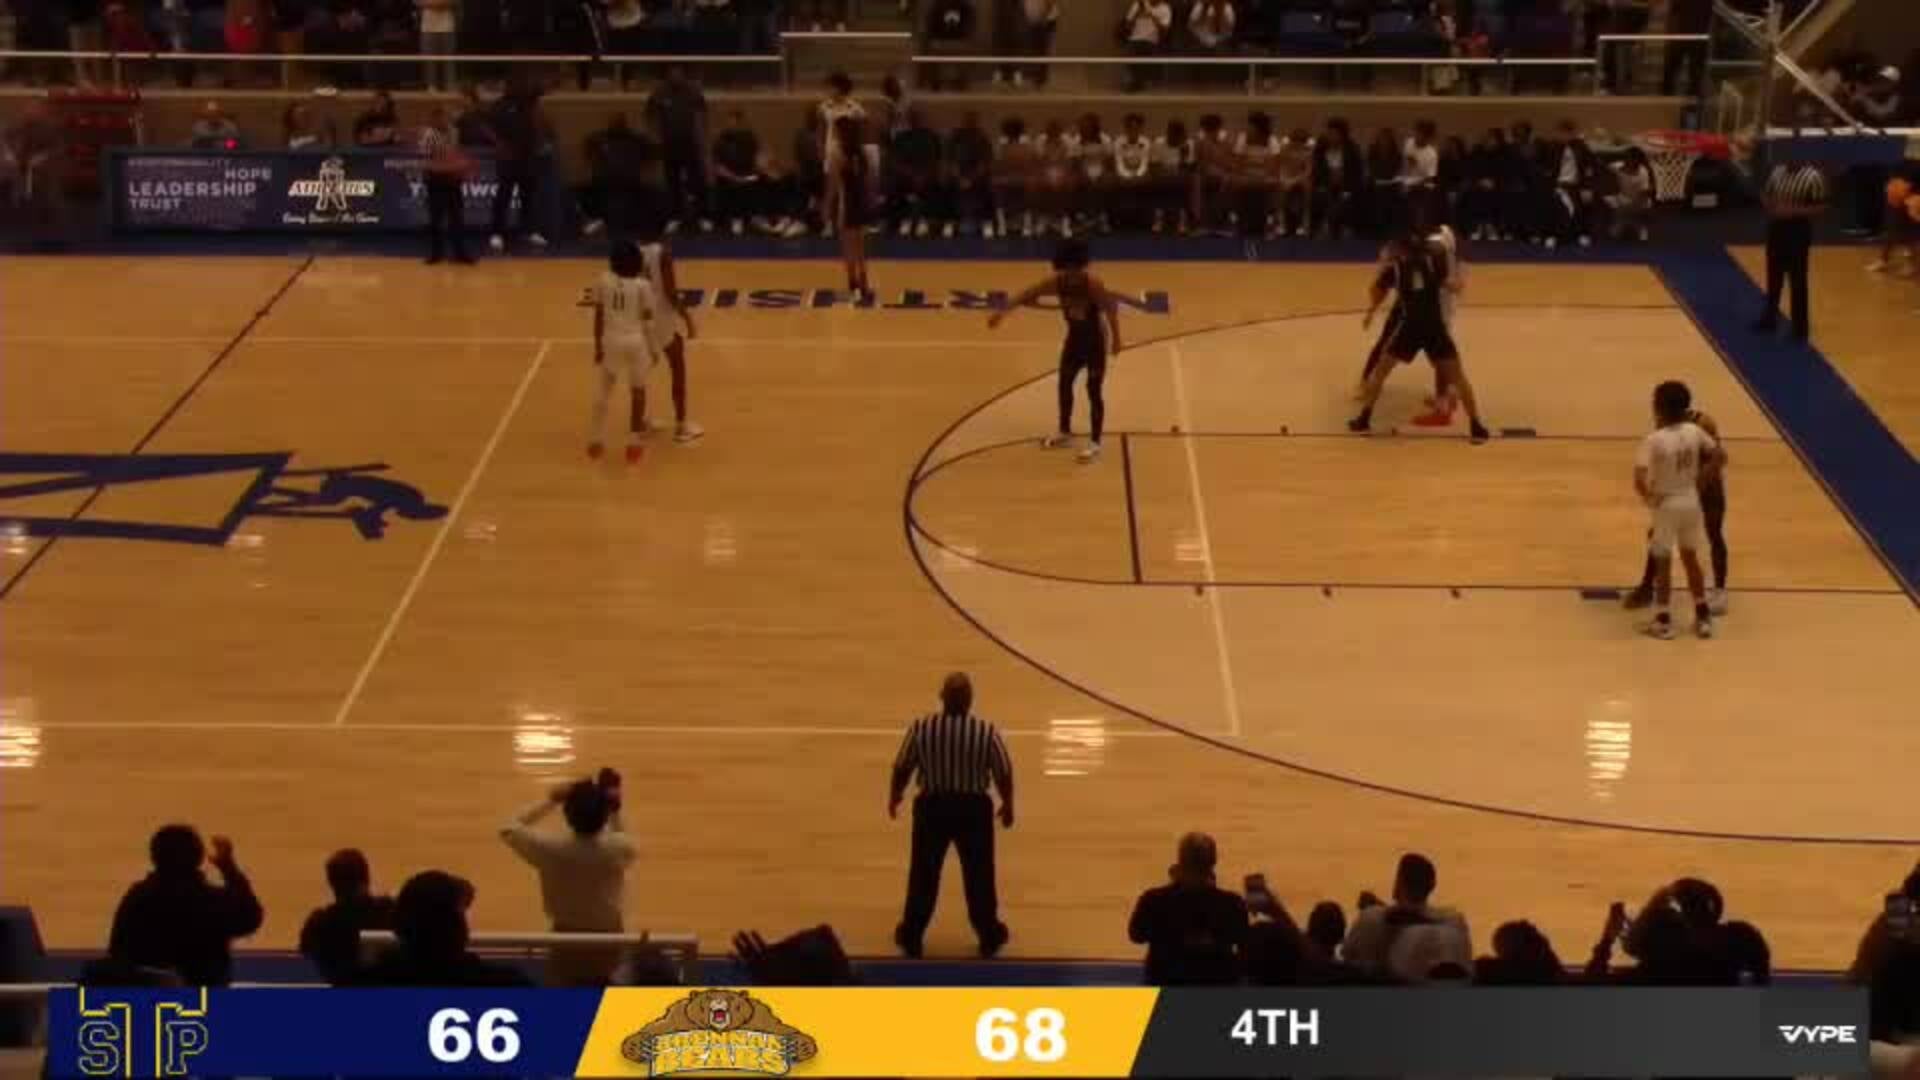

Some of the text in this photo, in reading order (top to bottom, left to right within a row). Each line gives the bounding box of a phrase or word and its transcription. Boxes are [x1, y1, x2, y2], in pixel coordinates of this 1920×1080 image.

[224, 167, 273, 181] HOPE
[128, 181, 257, 197] LEADERSHIP
[128, 198, 181, 210] TRUST
